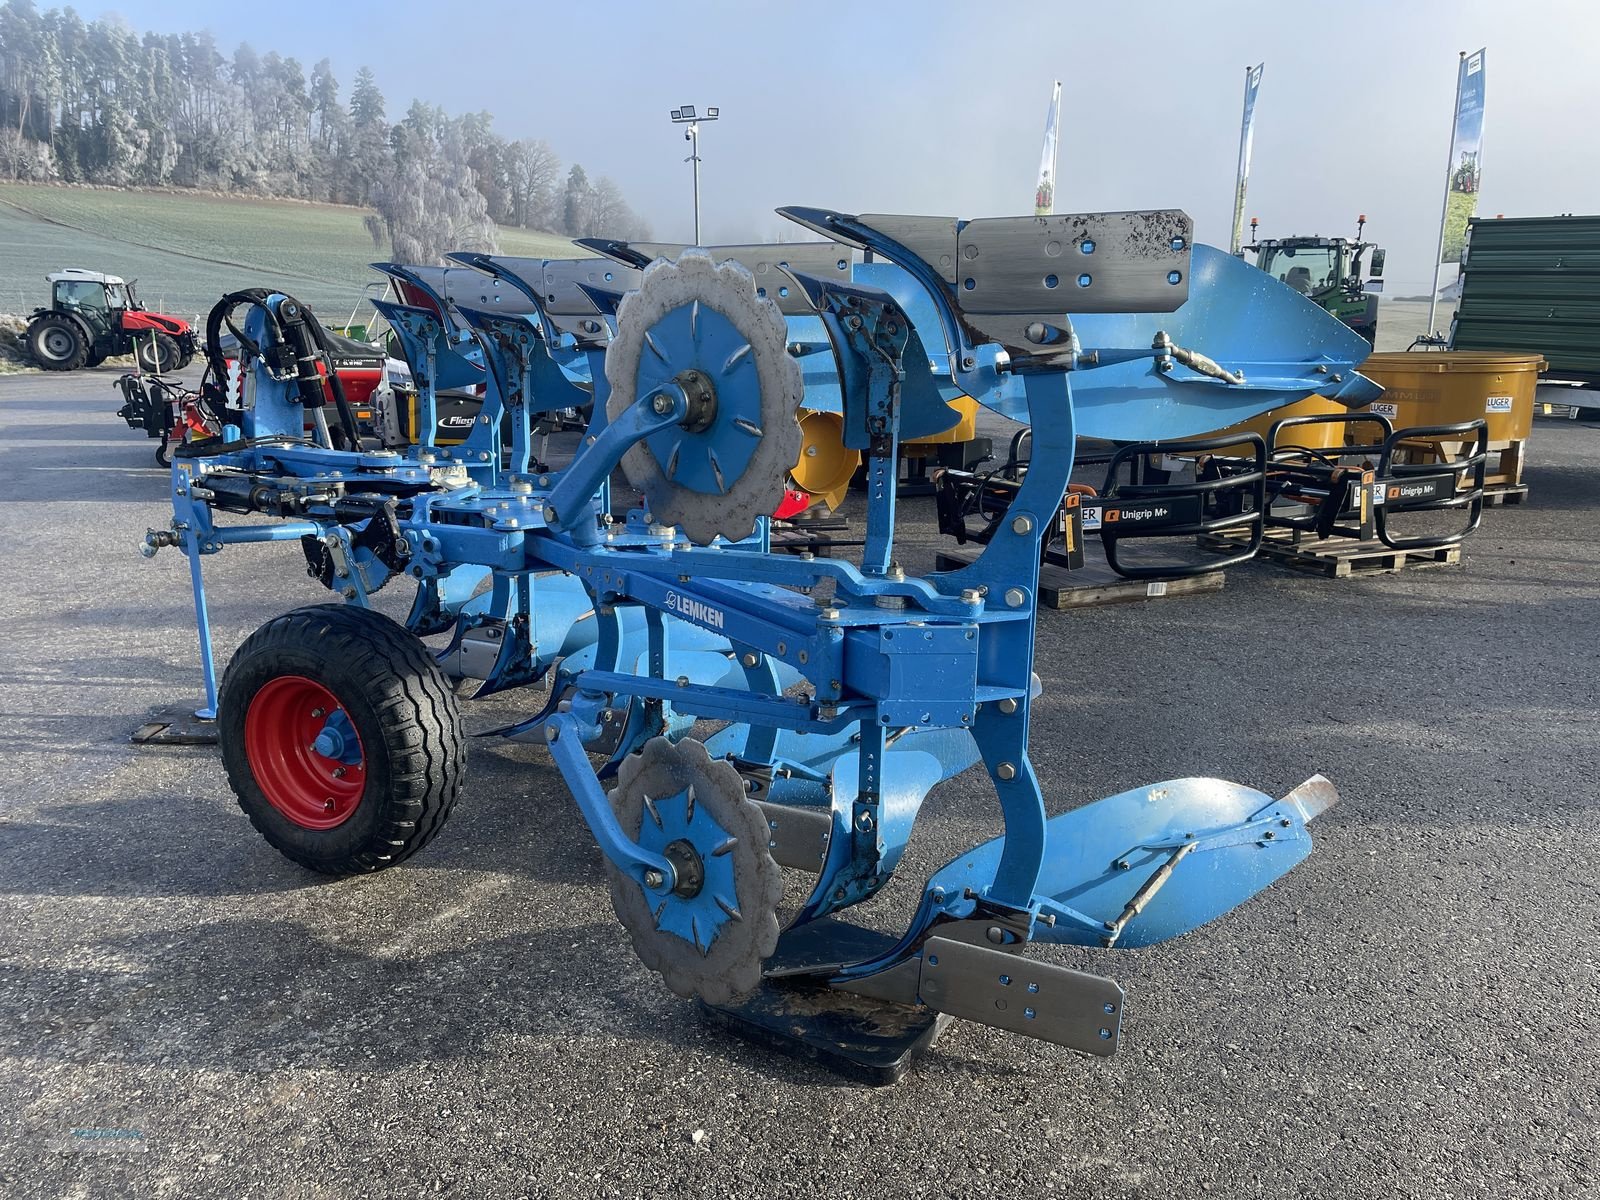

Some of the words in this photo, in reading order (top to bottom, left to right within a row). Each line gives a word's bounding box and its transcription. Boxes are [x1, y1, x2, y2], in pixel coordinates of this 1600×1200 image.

[1487, 398, 1509, 406] LUGER
[1370, 403, 1393, 413] LUGER
[450, 416, 476, 426] Fliegl
[1400, 485, 1423, 497] Unigrip
[1423, 485, 1434, 494] M+
[1121, 509, 1152, 520] Unigrip
[1154, 508, 1168, 517] M+
[677, 595, 724, 629] LEMKEN
